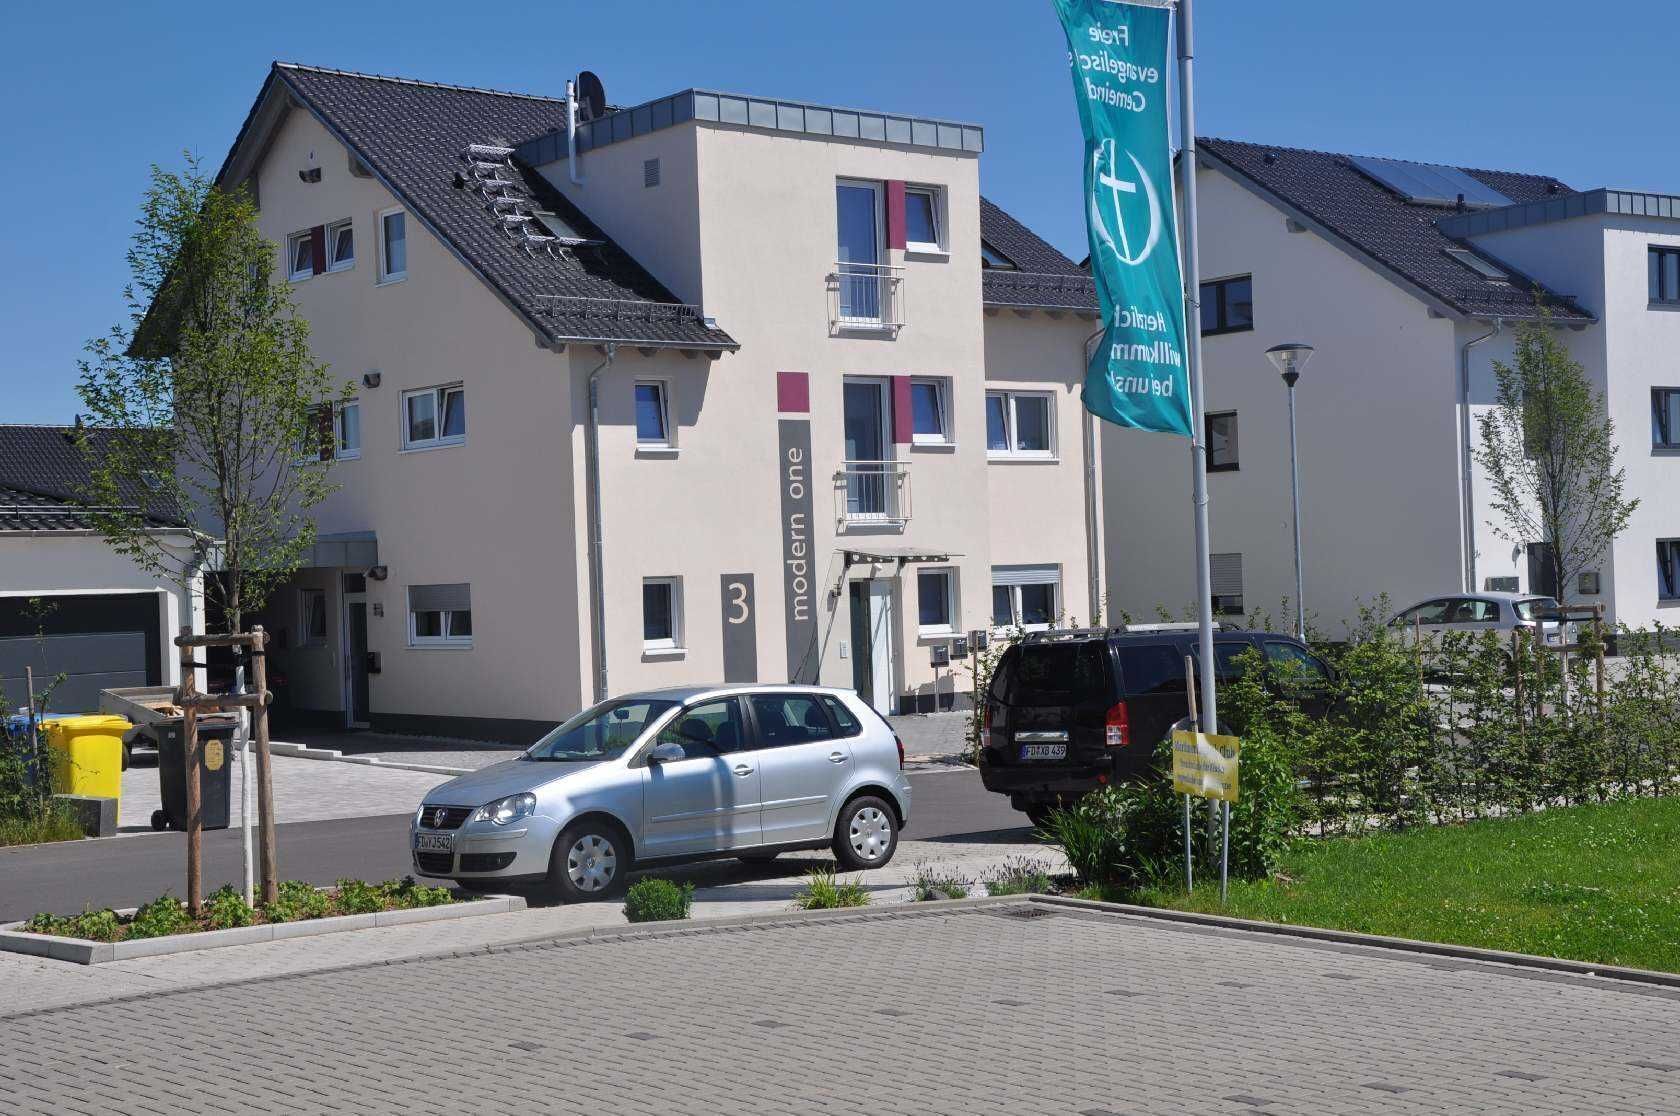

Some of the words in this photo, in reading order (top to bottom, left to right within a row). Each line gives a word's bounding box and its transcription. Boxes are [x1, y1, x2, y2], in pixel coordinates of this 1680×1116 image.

[788, 447, 804, 499] one
[787, 512, 809, 620] modern
[728, 582, 749, 624] 3
